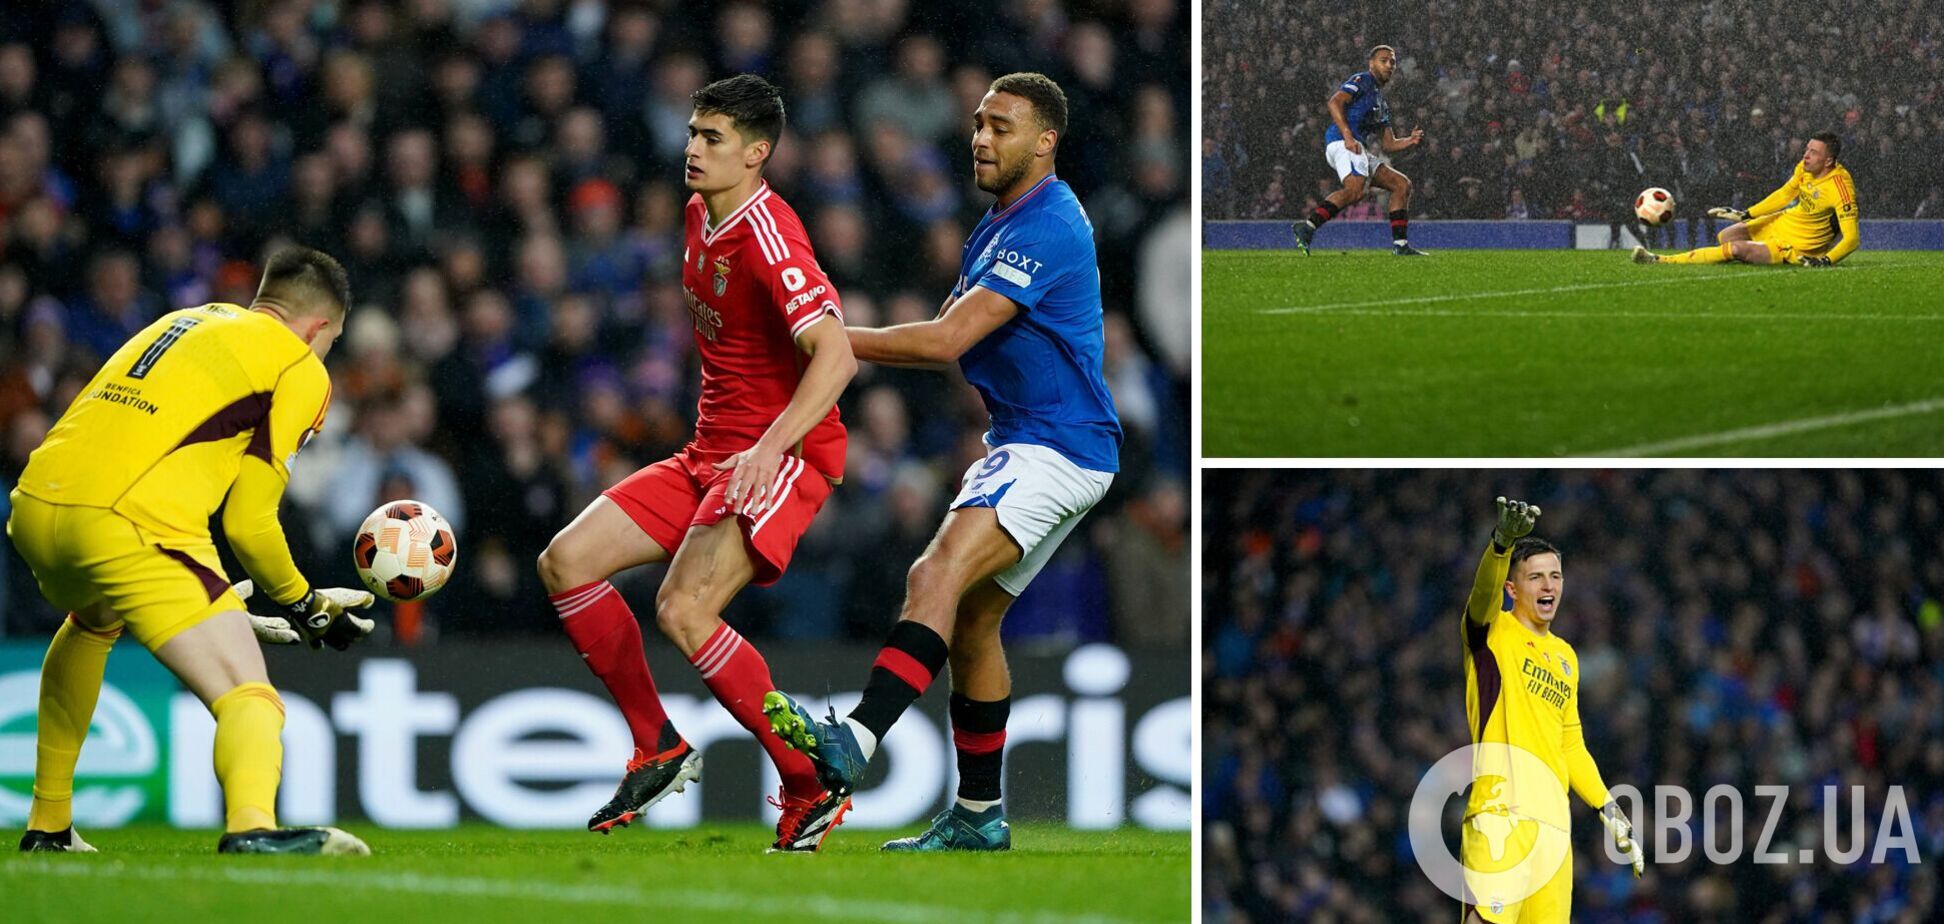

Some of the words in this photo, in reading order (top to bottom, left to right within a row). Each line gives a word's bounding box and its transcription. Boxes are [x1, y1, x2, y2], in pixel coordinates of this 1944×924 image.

[996, 248, 1043, 275] BOXT
[785, 285, 826, 315] BETANO
[126, 316, 203, 380] 1
[104, 382, 142, 396] BENFICA
[974, 450, 1010, 480] 9
[1522, 657, 1571, 699] Emirates
[1527, 679, 1542, 695] FLY
[1541, 686, 1566, 710] BETTER
